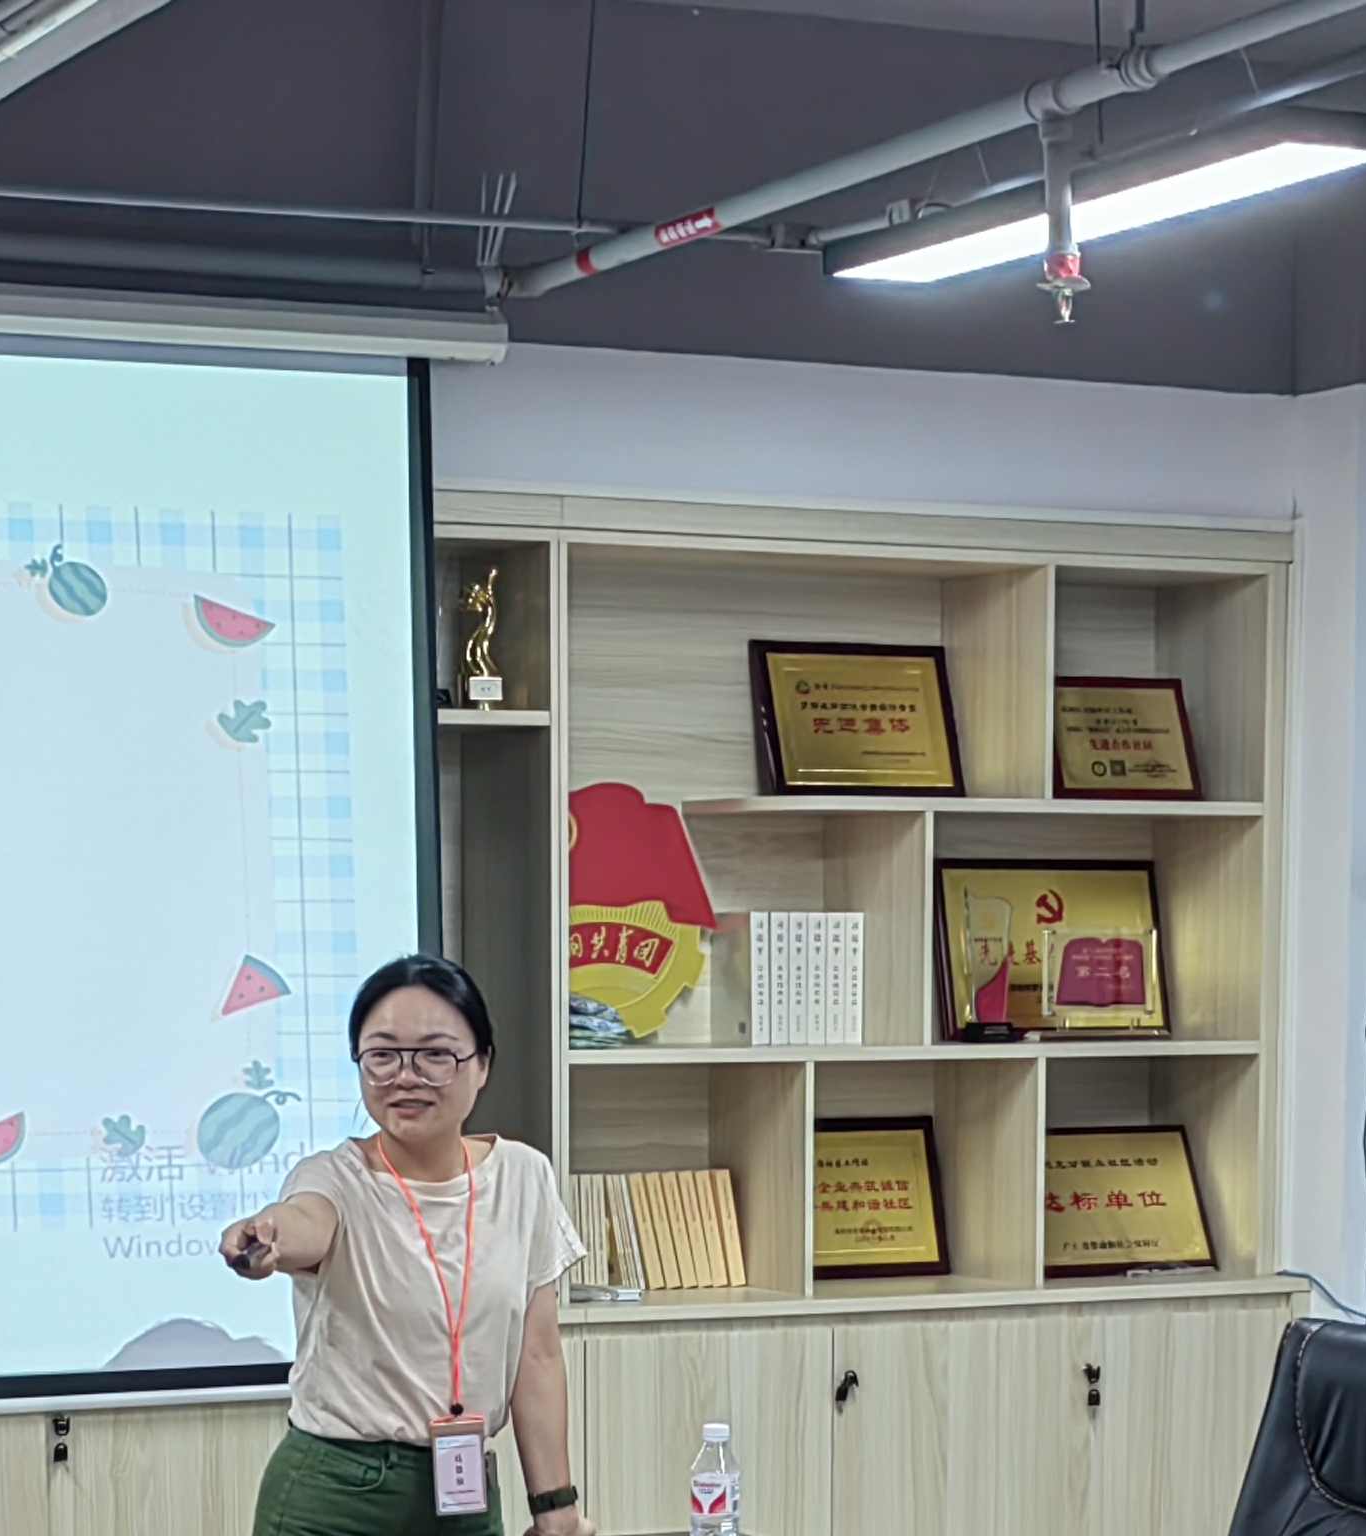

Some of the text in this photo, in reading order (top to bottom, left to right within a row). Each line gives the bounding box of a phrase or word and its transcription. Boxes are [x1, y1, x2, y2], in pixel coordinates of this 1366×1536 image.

[100, 1145, 185, 1183] 激活
[1045, 1189, 1167, 1213] 达标单位
